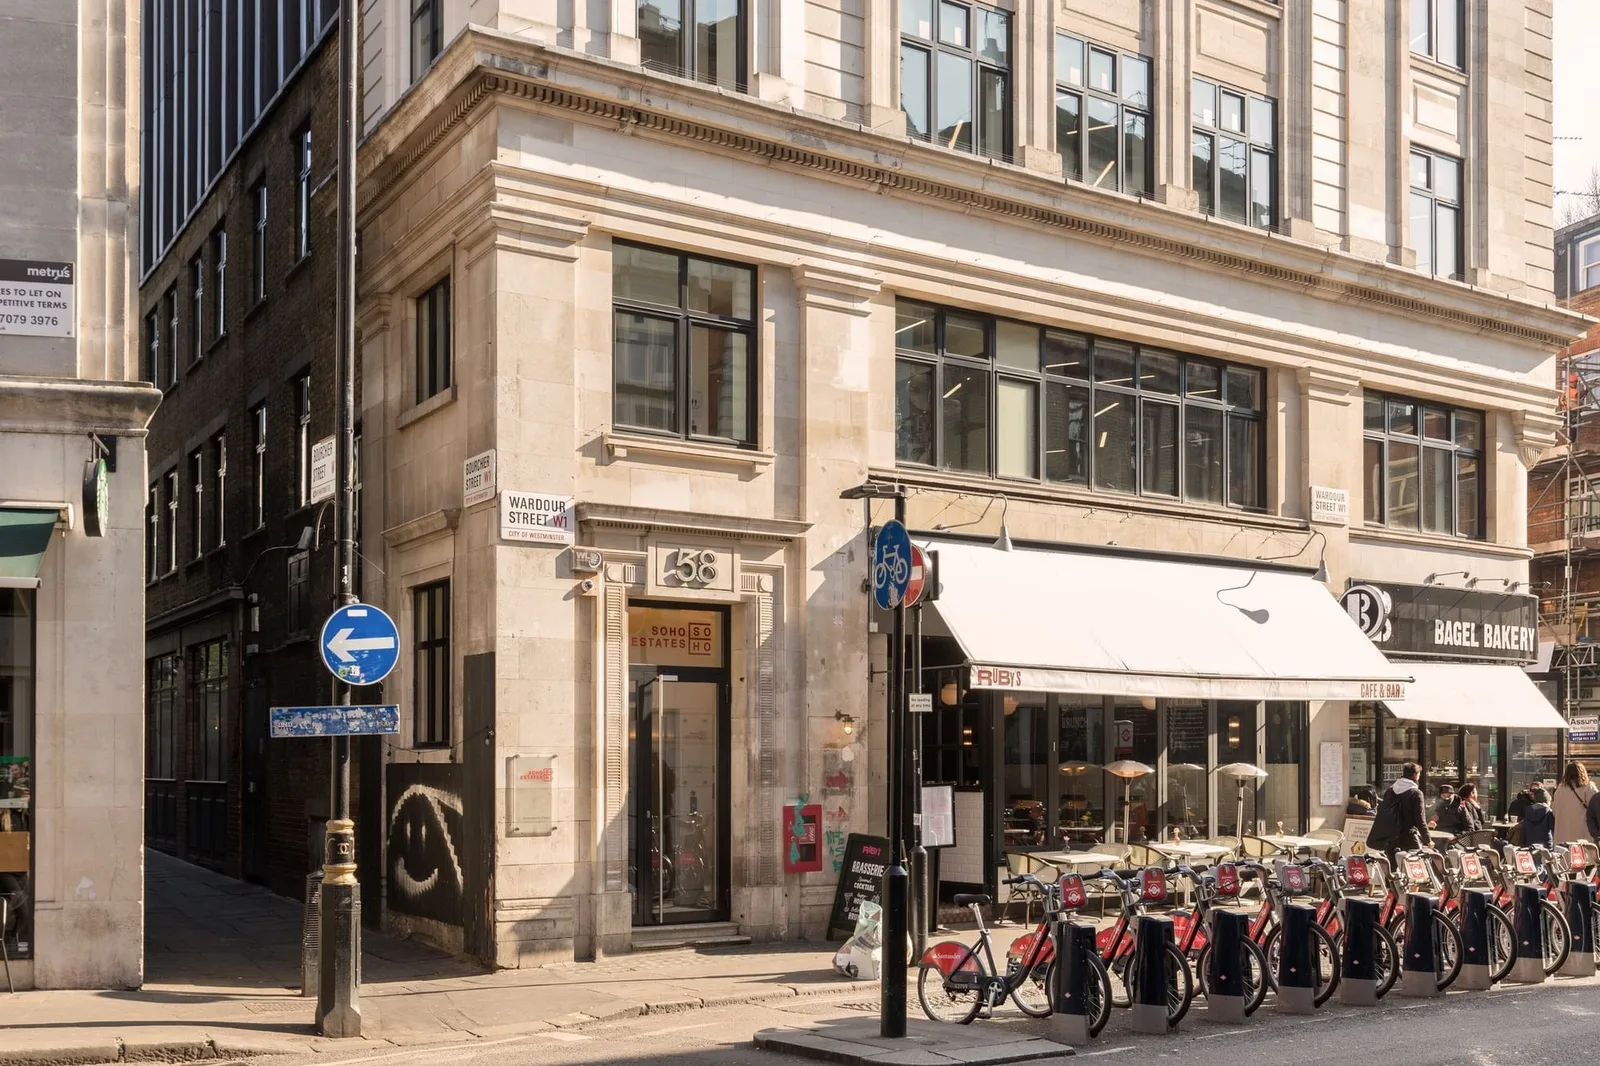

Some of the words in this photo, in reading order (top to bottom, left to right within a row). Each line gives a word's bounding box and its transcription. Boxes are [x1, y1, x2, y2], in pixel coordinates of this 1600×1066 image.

[27, 265, 71, 280] metrus
[37, 301, 68, 310] TERMS
[0, 314, 27, 325] 7079
[30, 316, 58, 326] 3976
[466, 474, 482, 490] STREET
[484, 470, 492, 483] W1
[1315, 490, 1345, 502] WARDOUR
[508, 496, 566, 513] WARDOUR
[1315, 501, 1336, 512] STREET
[1338, 504, 1346, 513] W1
[508, 511, 549, 526] STREET
[553, 515, 568, 528] W1
[529, 532, 565, 541] WESTMINSTER
[676, 548, 719, 584] 58
[652, 626, 686, 637] SOHO
[1434, 619, 1480, 648] BAGEL
[1483, 623, 1536, 652] BAKERY
[631, 637, 686, 648] ESTATES
[1361, 683, 1377, 698] CAFE
[1380, 683, 1385, 698] &
[1387, 684, 1400, 698] BAR
[851, 860, 884, 877] BRASSERIE
[937, 952, 961, 960] Santander
